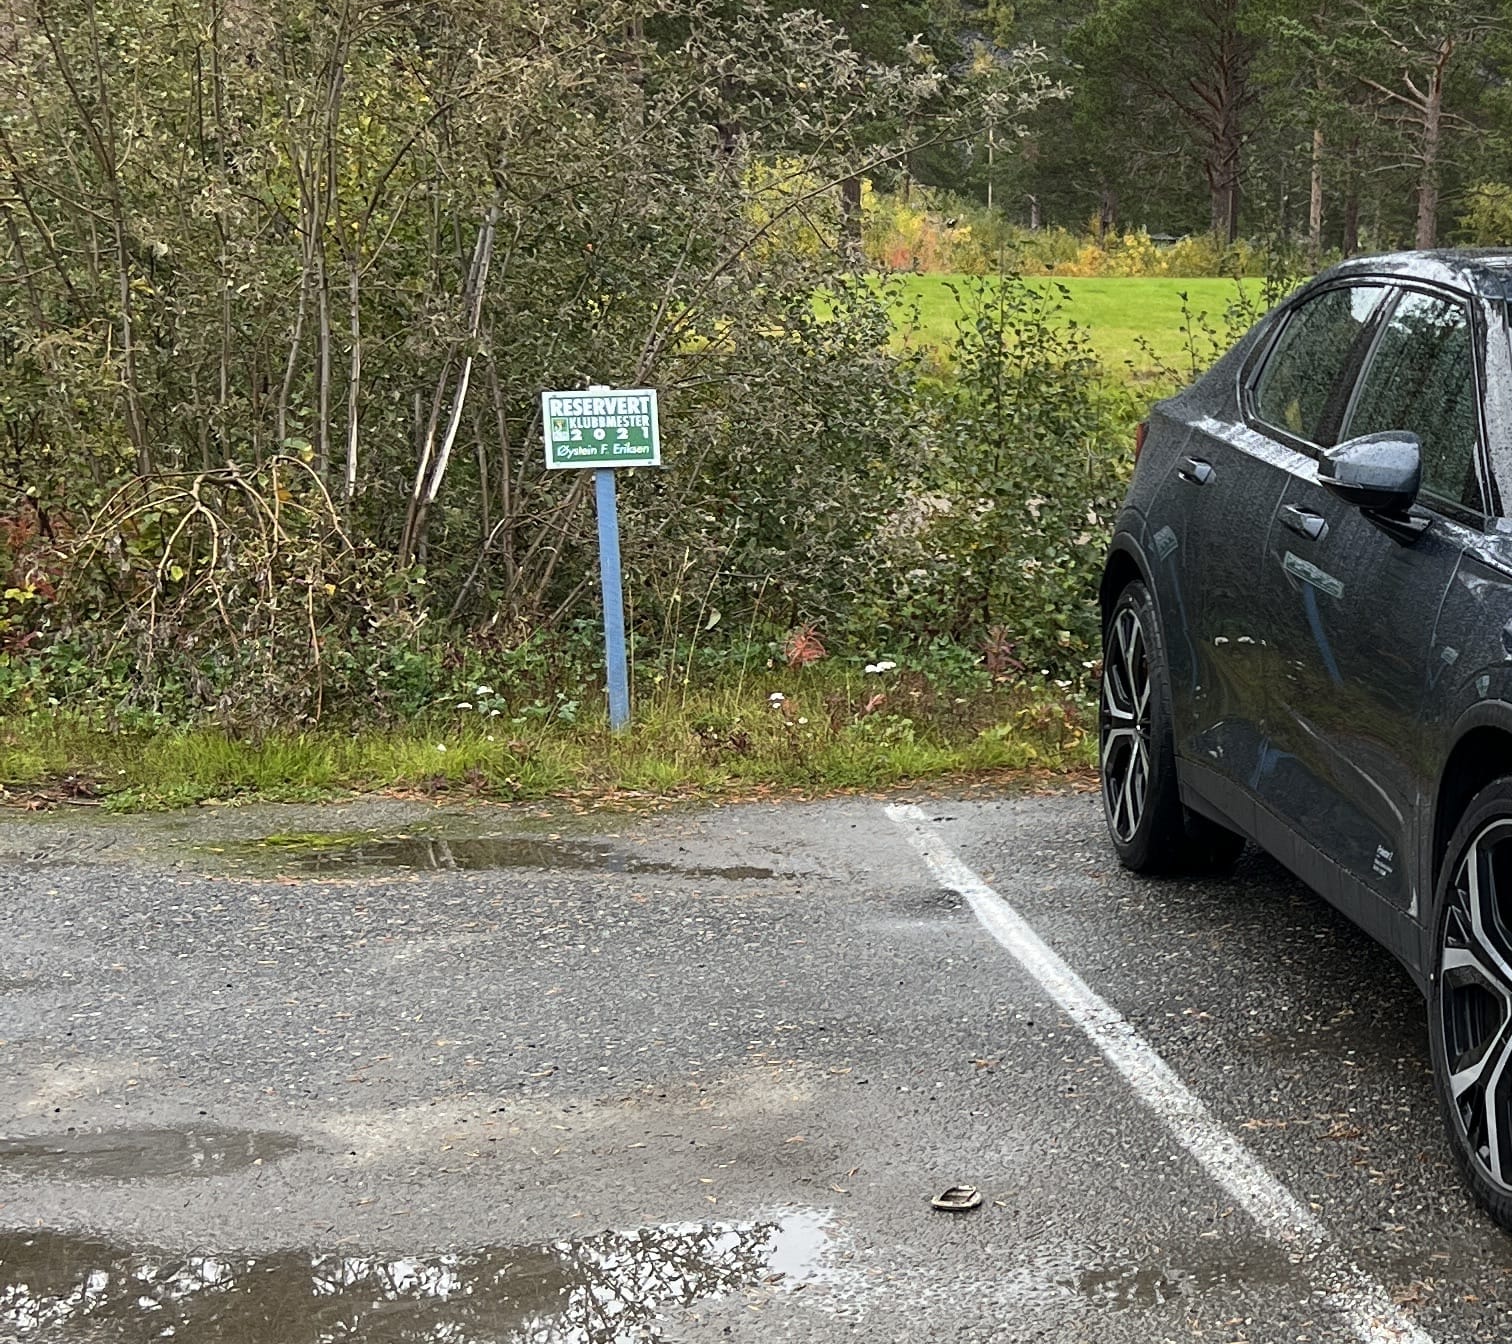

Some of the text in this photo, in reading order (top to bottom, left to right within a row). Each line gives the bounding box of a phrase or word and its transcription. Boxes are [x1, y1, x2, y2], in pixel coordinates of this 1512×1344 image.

[550, 397, 650, 416] RESERVERT
[569, 415, 650, 428] KLUBBMESTER
[557, 444, 598, 458] Øystein
[613, 442, 650, 455] Eriksen
